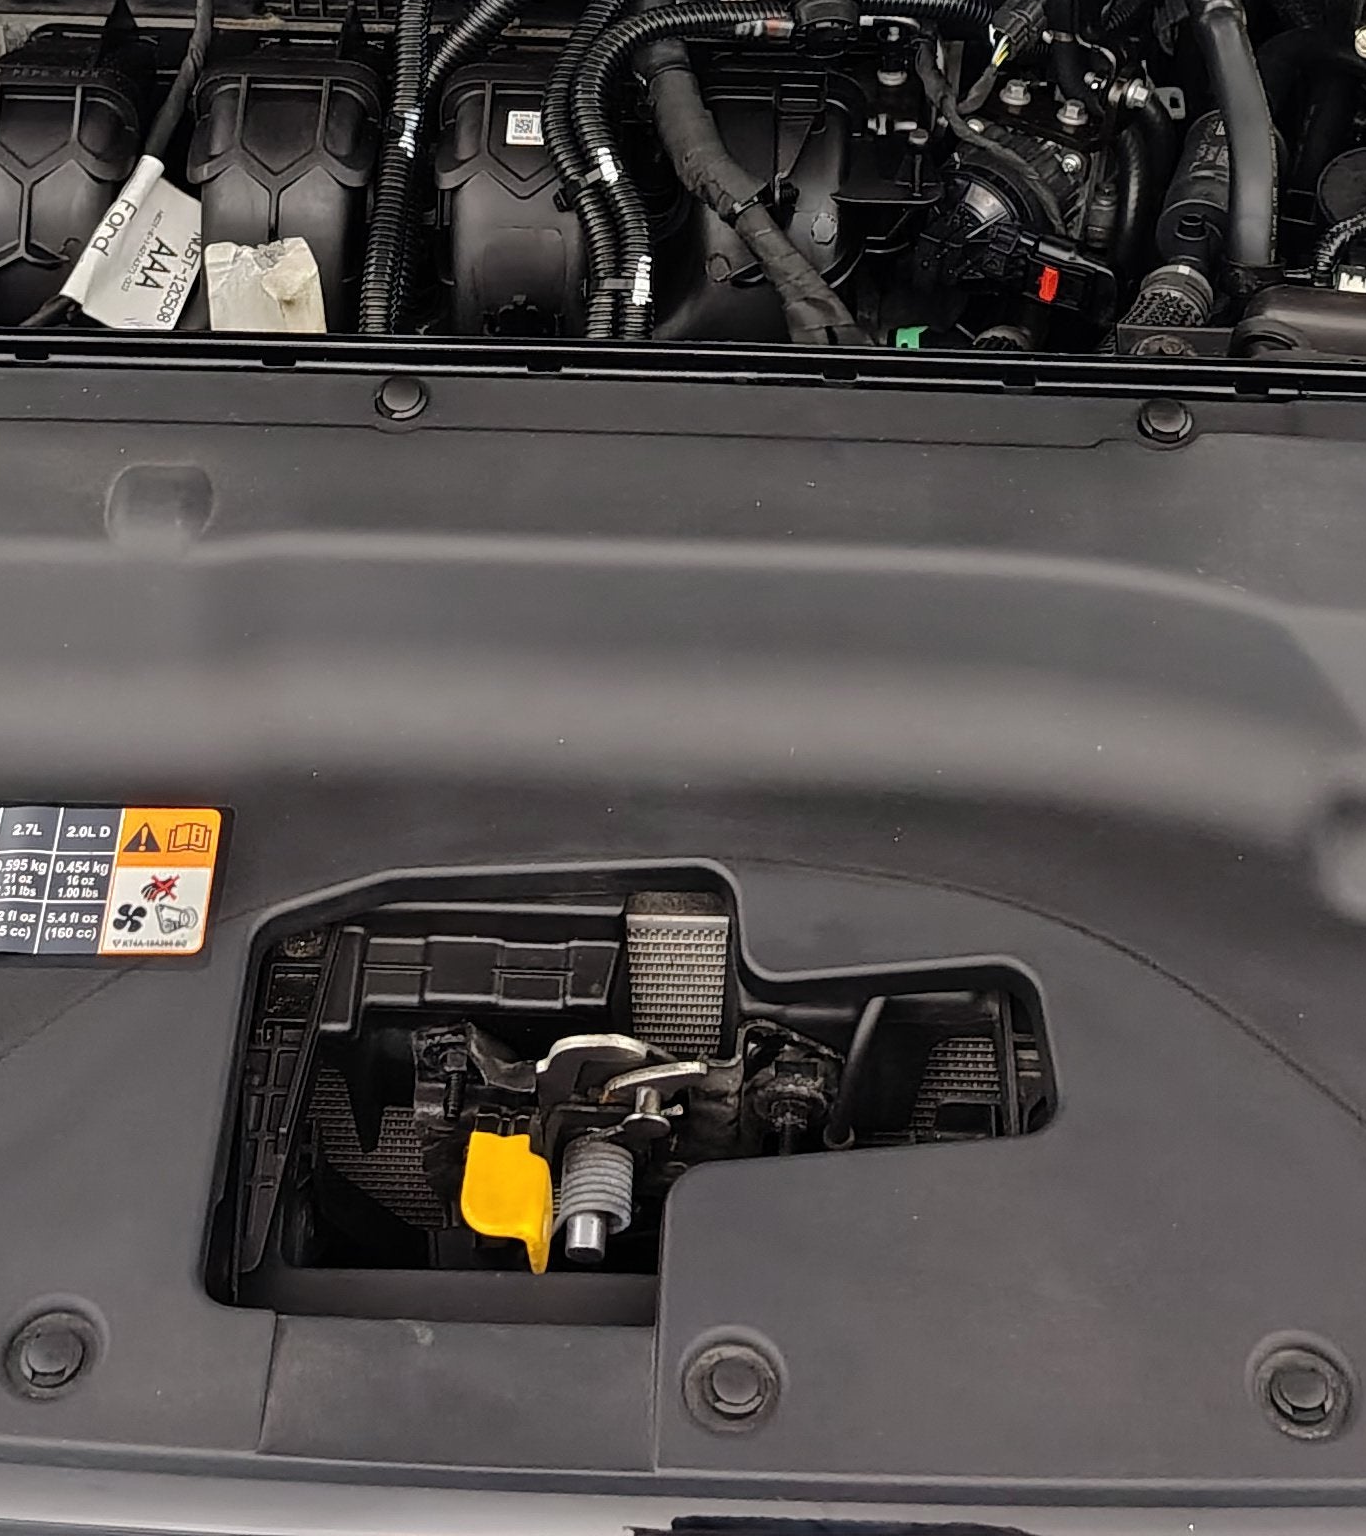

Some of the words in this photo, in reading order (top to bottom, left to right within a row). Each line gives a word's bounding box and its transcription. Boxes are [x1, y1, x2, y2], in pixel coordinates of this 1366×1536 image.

[91, 199, 137, 256] Ford
[135, 237, 178, 289] AAA
[12, 823, 42, 836] 2.7L
[66, 825, 96, 838] 2.0L
[100, 825, 111, 838] D
[30, 860, 47, 877] kg
[55, 861, 88, 873] 0.454
[91, 861, 108, 877] kg
[3, 874, 15, 885] 21
[19, 876, 33, 885] oz
[67, 876, 78, 886] 16
[81, 877, 95, 886] oz
[20, 886, 36, 897] lbs
[58, 887, 78, 898] 1.00
[81, 887, 99, 898] lbs
[8, 911, 18, 923] fl
[21, 913, 36, 923] oz
[46, 912, 66, 925] 5.4
[70, 912, 79, 925] fl
[83, 914, 98, 925] oz
[11, 926, 31, 940] cc)
[44, 927, 72, 941] (160
[75, 927, 96, 941] cc)
